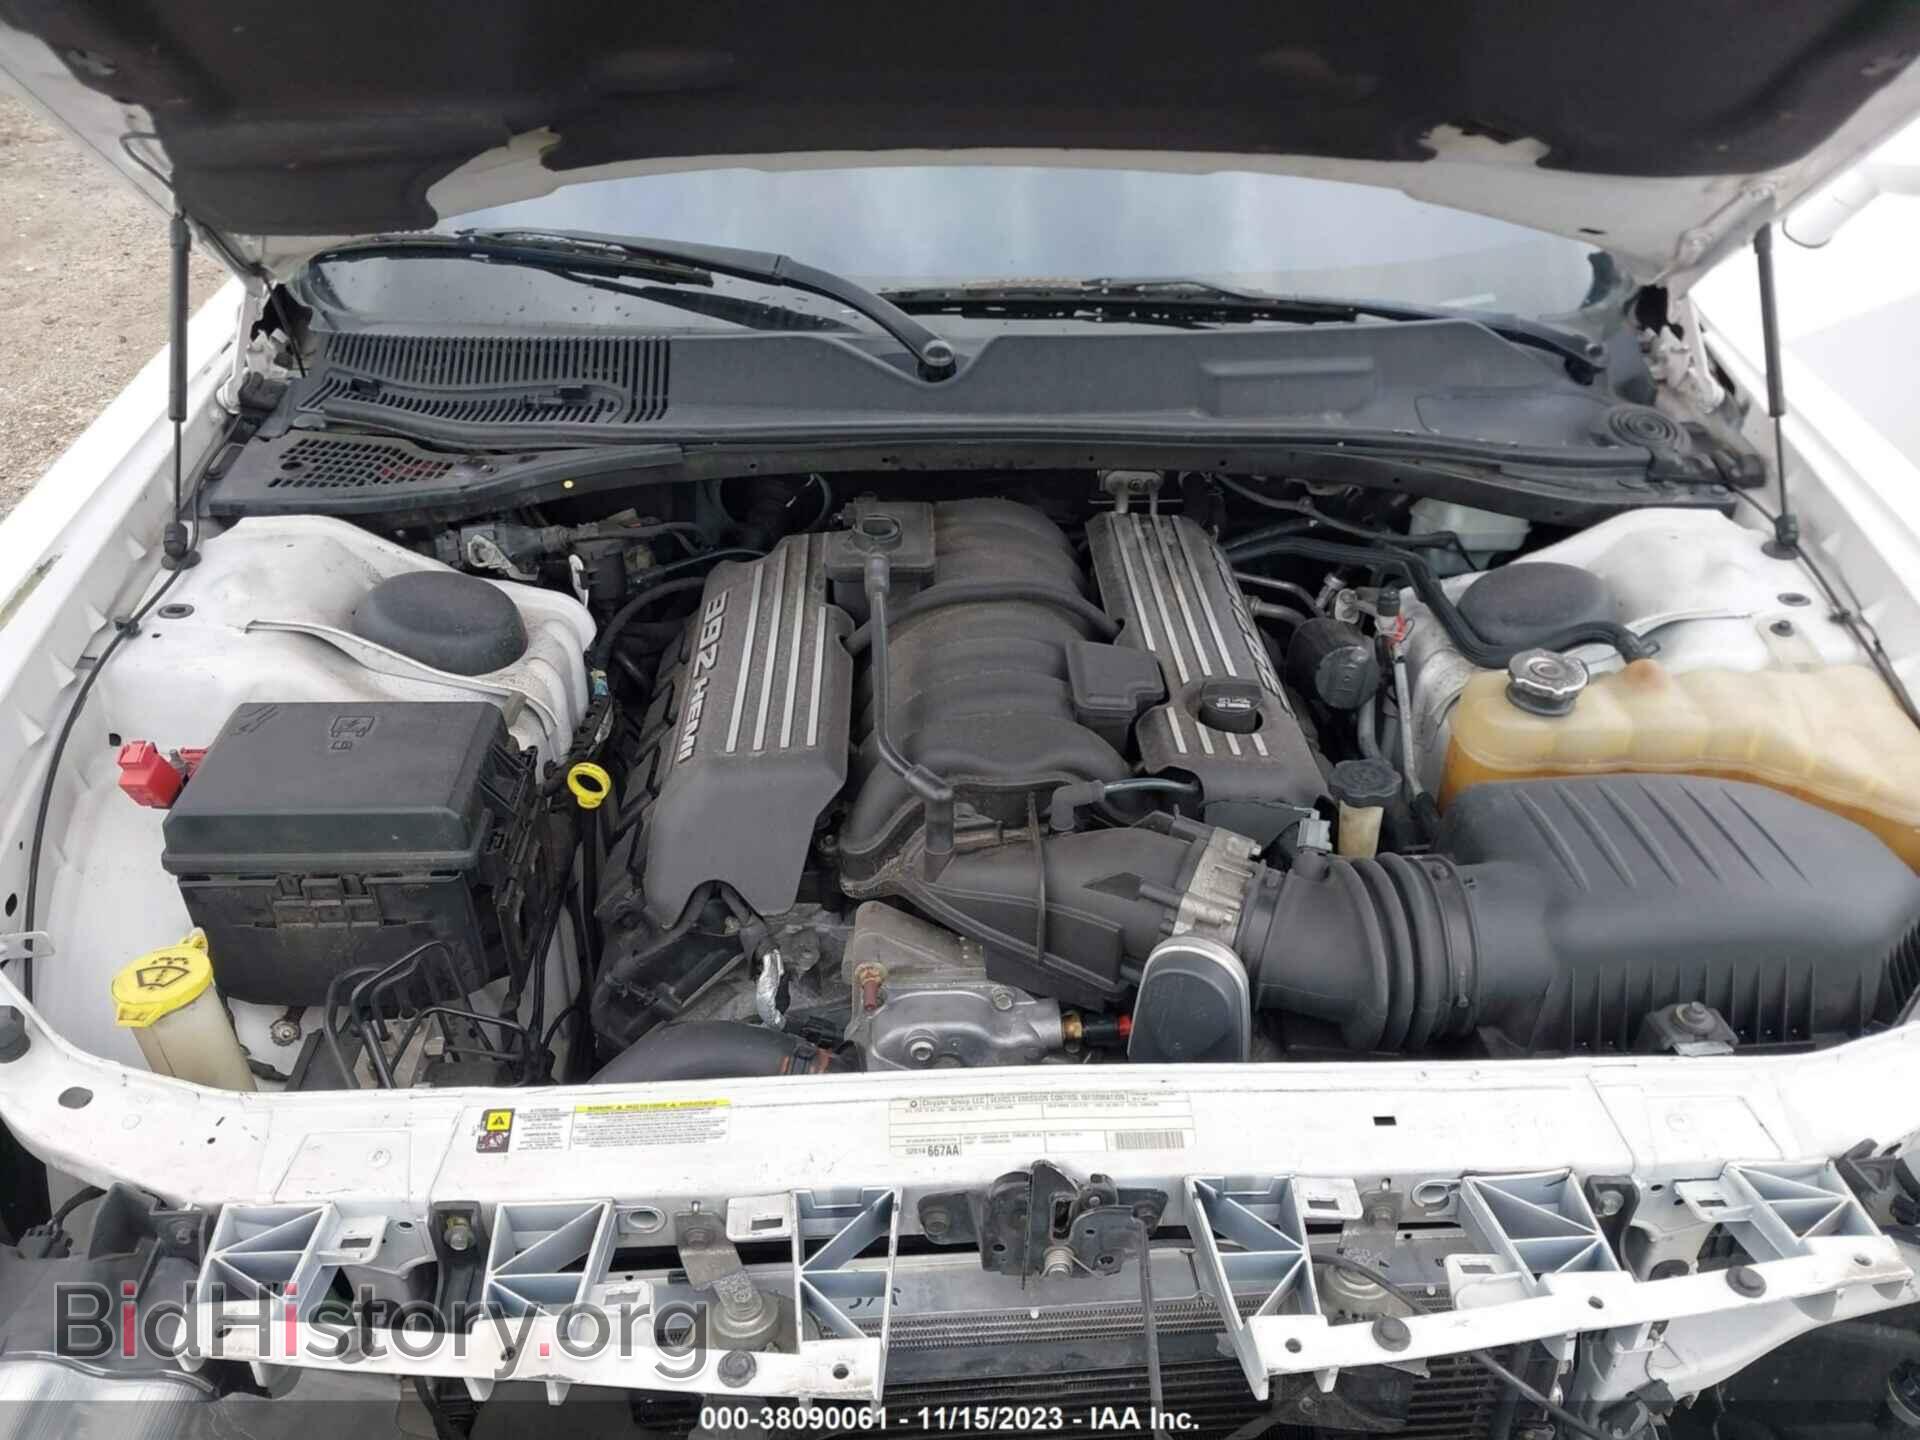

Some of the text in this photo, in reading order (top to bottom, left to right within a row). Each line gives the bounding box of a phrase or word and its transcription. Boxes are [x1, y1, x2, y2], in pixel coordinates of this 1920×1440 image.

[677, 591, 730, 763] 392 HEMI
[927, 1145, 959, 1157] 667AA
